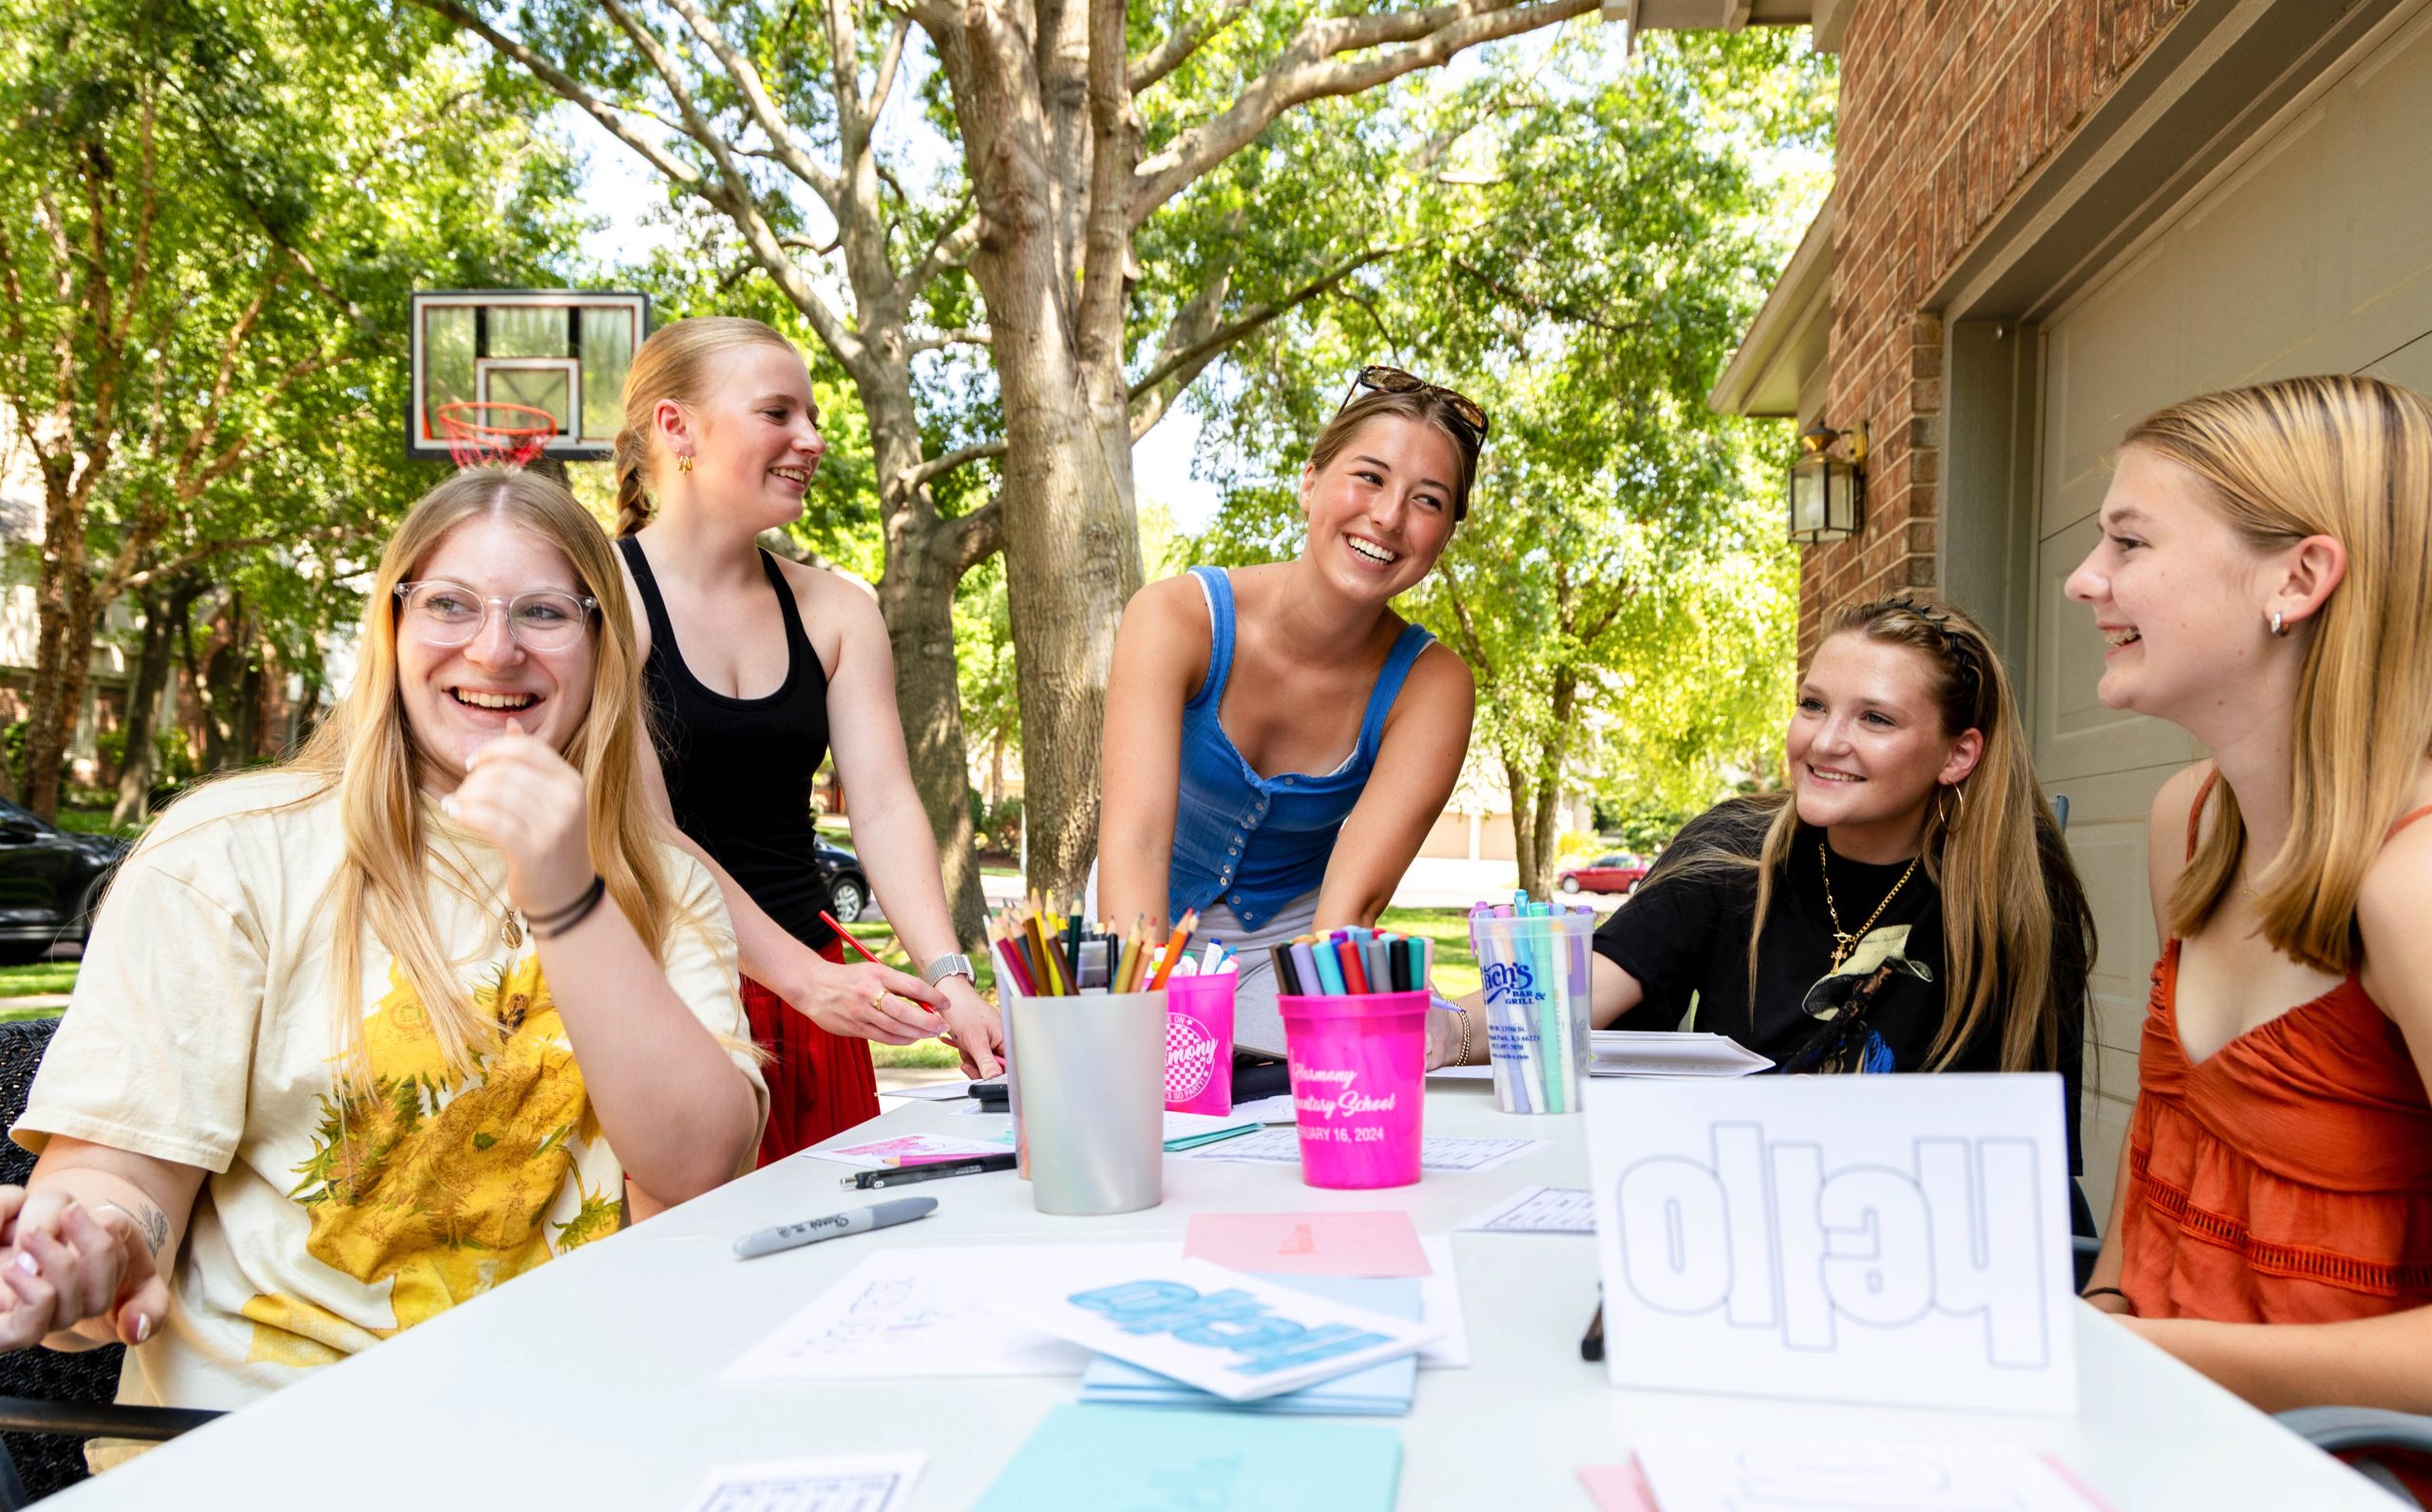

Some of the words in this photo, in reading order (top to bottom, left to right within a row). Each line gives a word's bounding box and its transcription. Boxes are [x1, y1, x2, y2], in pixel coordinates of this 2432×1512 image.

[1483, 962, 1533, 991] ach's
[1534, 992, 1546, 1001] &
[1166, 1037, 1219, 1066] mony
[1185, 1077, 1206, 1098] PARTY!
[1293, 1063, 1358, 1090] Harmony
[1338, 1090, 1396, 1118] School
[1334, 1127, 1352, 1143] 16,
[1355, 1126, 1384, 1142] 2024
[1616, 1121, 2049, 1369] hello
